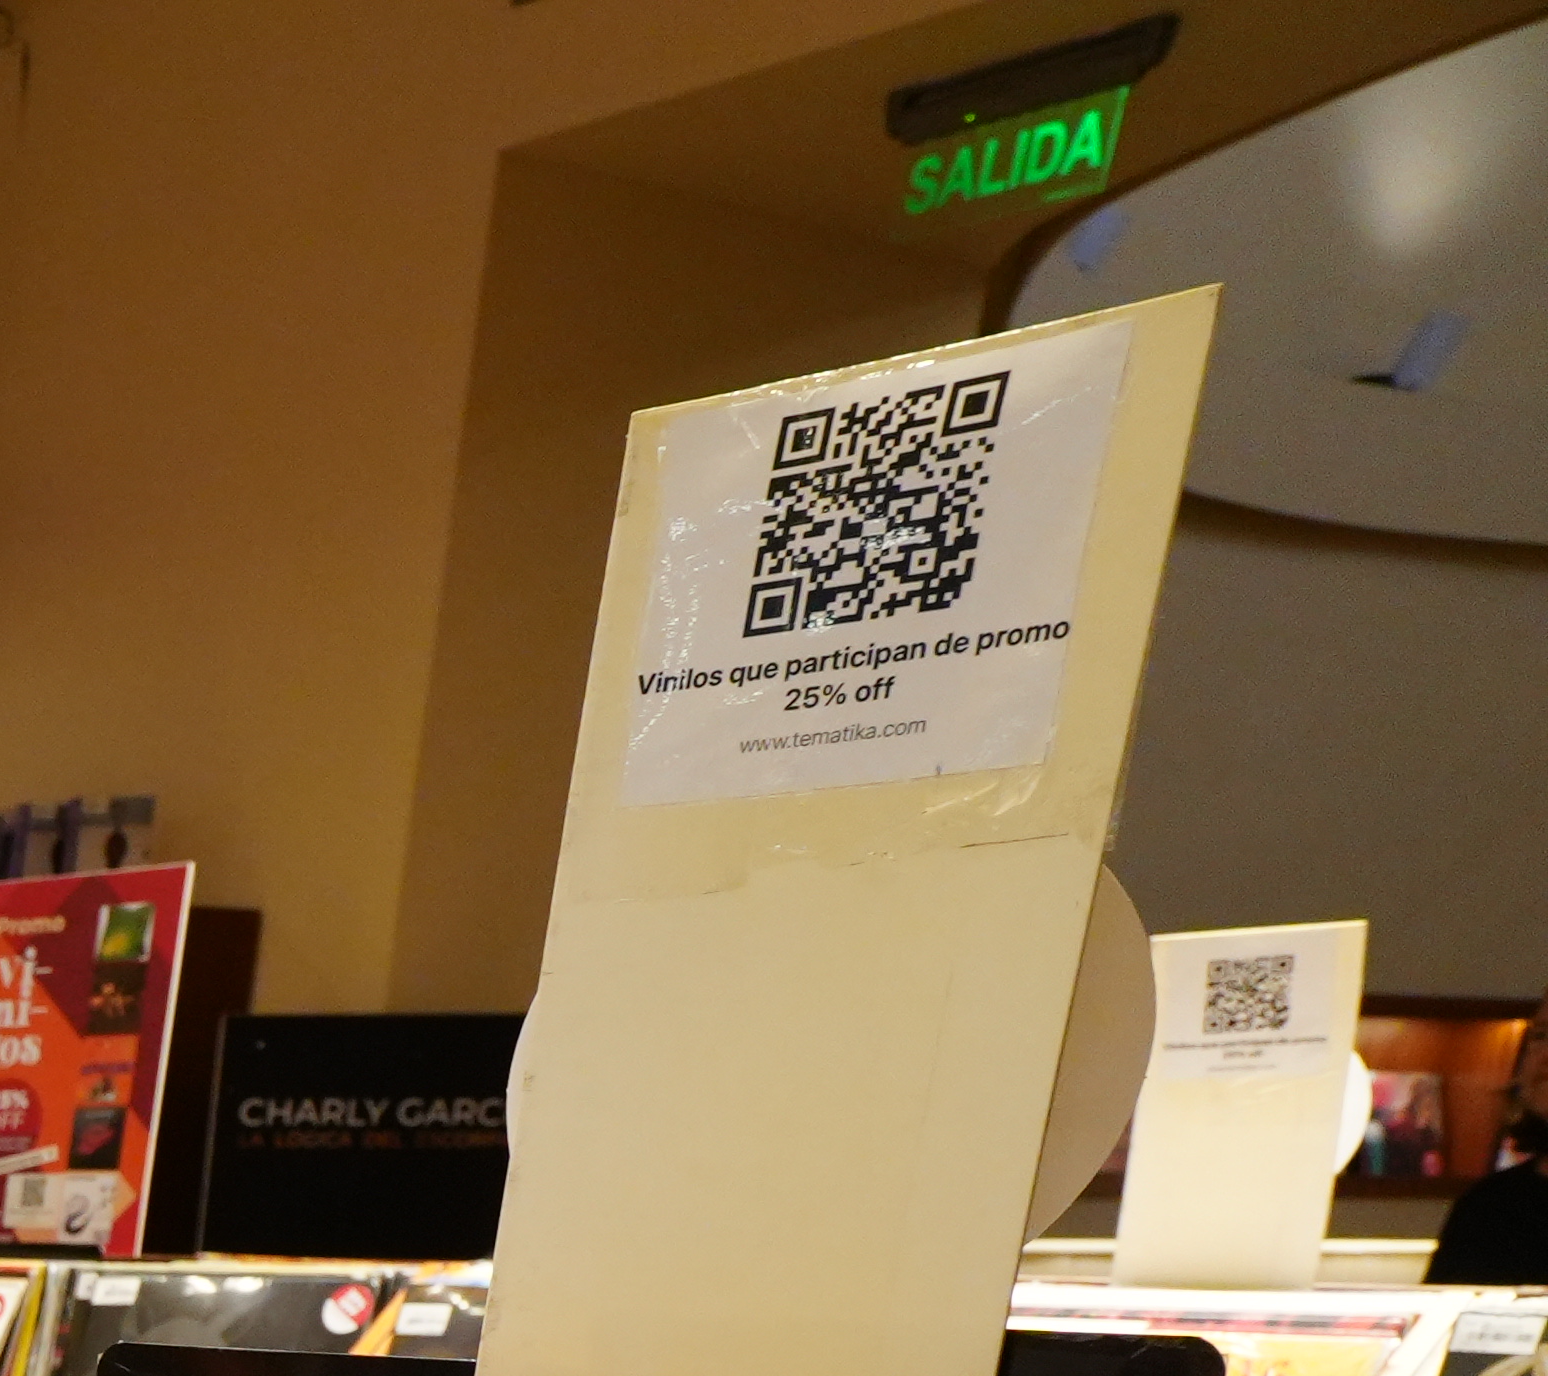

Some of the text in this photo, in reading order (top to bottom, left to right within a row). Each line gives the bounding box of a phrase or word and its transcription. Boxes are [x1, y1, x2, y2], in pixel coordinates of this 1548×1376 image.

[905, 109, 1103, 215] SALIDA
[637, 620, 1071, 696] Vinilos que participan de promo
[783, 676, 896, 712] 25% off
[739, 716, 927, 755] www.tematika.com
[237, 1096, 507, 1128] CHARLY GARC
